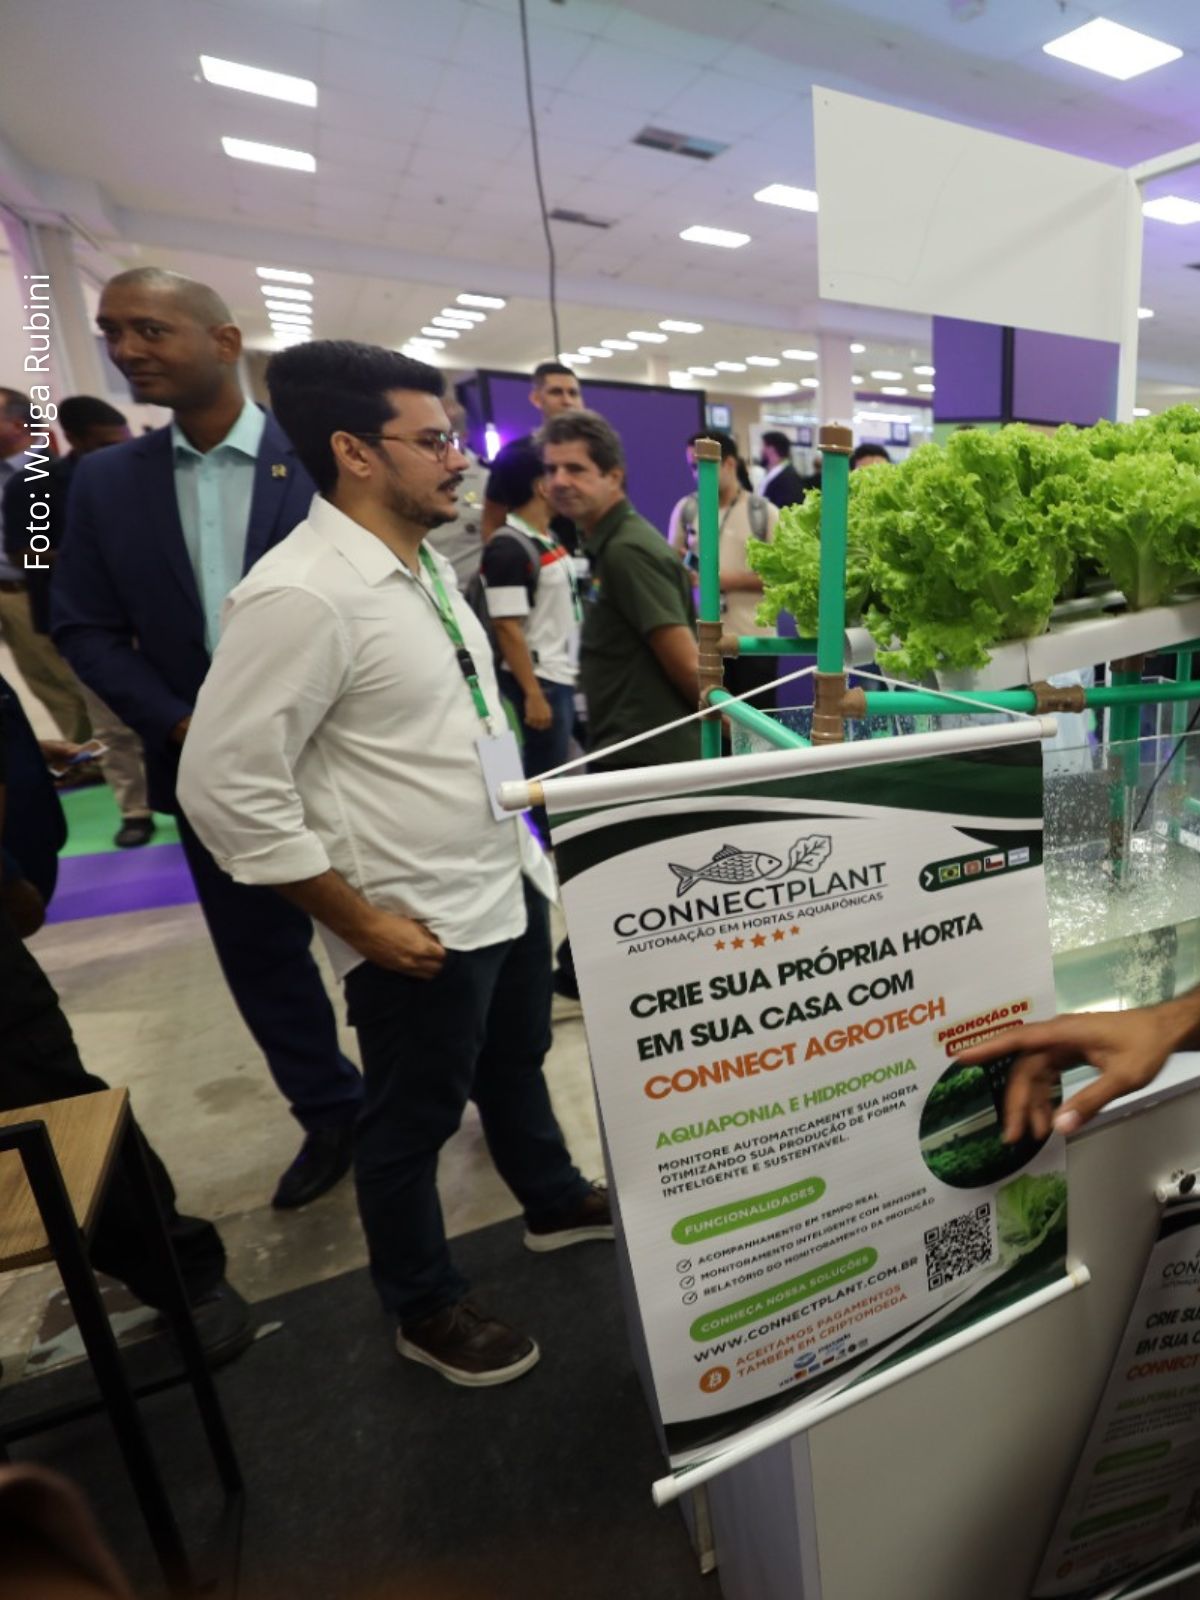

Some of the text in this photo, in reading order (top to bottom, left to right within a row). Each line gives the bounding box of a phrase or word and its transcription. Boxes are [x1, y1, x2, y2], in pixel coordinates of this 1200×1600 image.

[613, 862, 887, 937] CONNECTPLANT
[627, 891, 884, 955] AUTOMAÇÃO EM HORTAS AQUAPÔNICAS
[630, 912, 983, 1019] CRIE SUA PRÓPRIA HORTA
[637, 969, 914, 1061] EM SUA CASA COM
[644, 996, 946, 1100] CONNECT AGROTECH
[938, 1001, 1028, 1042] PROMOÇÃO DE
[656, 1058, 917, 1150] AQUAPONIA E HIDROPONIA
[658, 1083, 918, 1173] MONITORE AUTOMATICAMENTE SUA HORTA
[660, 1100, 907, 1185] OTIMIZANDO SUA PRODUÇÃO DE FORMA
[662, 1165, 749, 1198] INTELIGENTE
[752, 1162, 760, 1173] E
[685, 1185, 816, 1237] FUNCIONALIDADES
[698, 1192, 879, 1265] ACOMPANHAMENTO EM TEMPO REAL
[701, 1242, 794, 1281] MONITORAMENTO
[796, 1216, 856, 1245] INTELIGENTE
[859, 1206, 880, 1219] COM
[703, 1267, 764, 1296] RELATÓRIO
[766, 1261, 782, 1273] DO
[784, 1225, 868, 1265] MONITORAMENTO
[870, 1218, 884, 1229] DA
[694, 1255, 918, 1363] WWW.CONNECTPLANT.COM.BR
[736, 1325, 814, 1366] ACEITAMOS
[817, 1284, 901, 1328] PAGAMENTOS
[798, 1335, 816, 1350] EM
[820, 1292, 908, 1340] CRIPTOMOEDA
[1136, 1338, 1158, 1356] EM
[1159, 1332, 1188, 1350] SUA
[1146, 1309, 1178, 1329] CRIE
[1126, 1350, 1200, 1381] CONNECT
